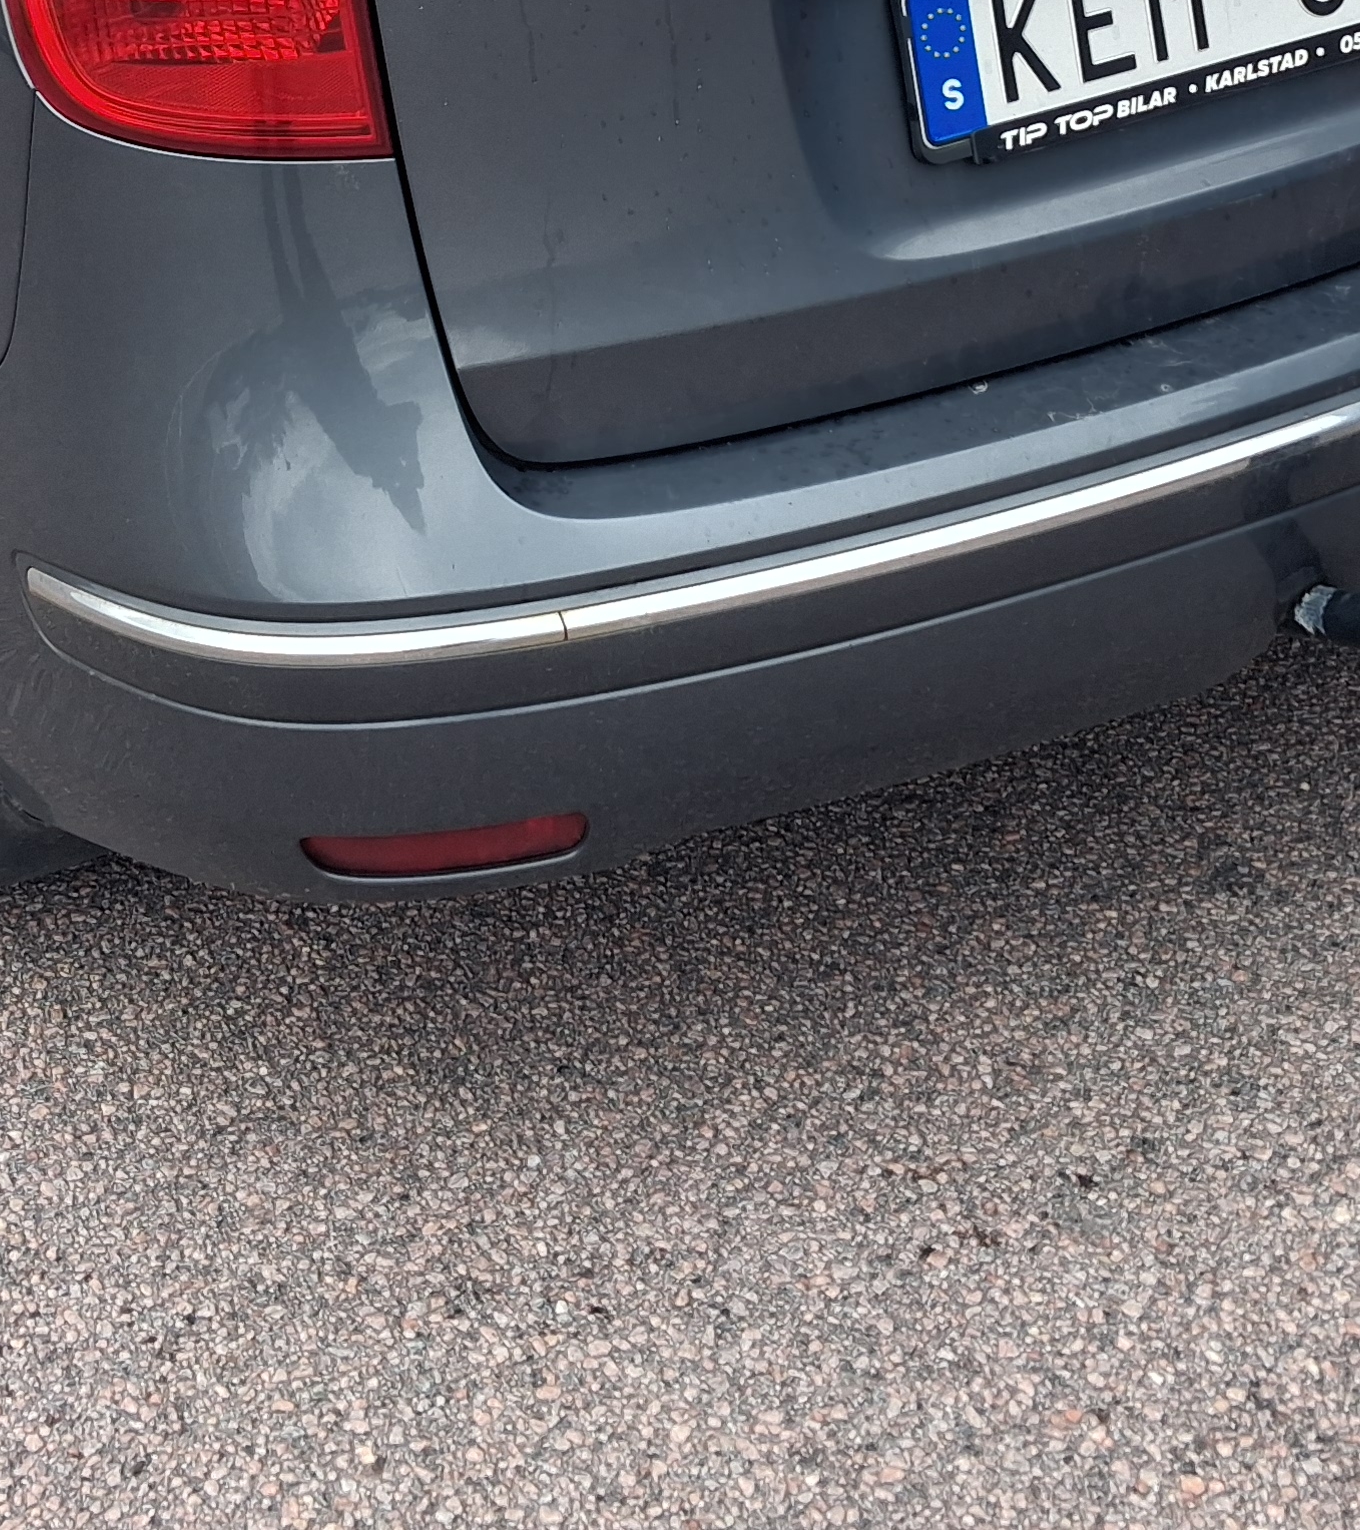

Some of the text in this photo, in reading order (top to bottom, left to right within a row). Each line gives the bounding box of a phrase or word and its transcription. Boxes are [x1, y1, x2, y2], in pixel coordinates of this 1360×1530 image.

[942, 78, 965, 111] S
[1000, 122, 1048, 150] TIP
[1054, 103, 1114, 135] TOP
[1116, 86, 1178, 119] BILAR
[1204, 48, 1309, 93] KARLSTAD
